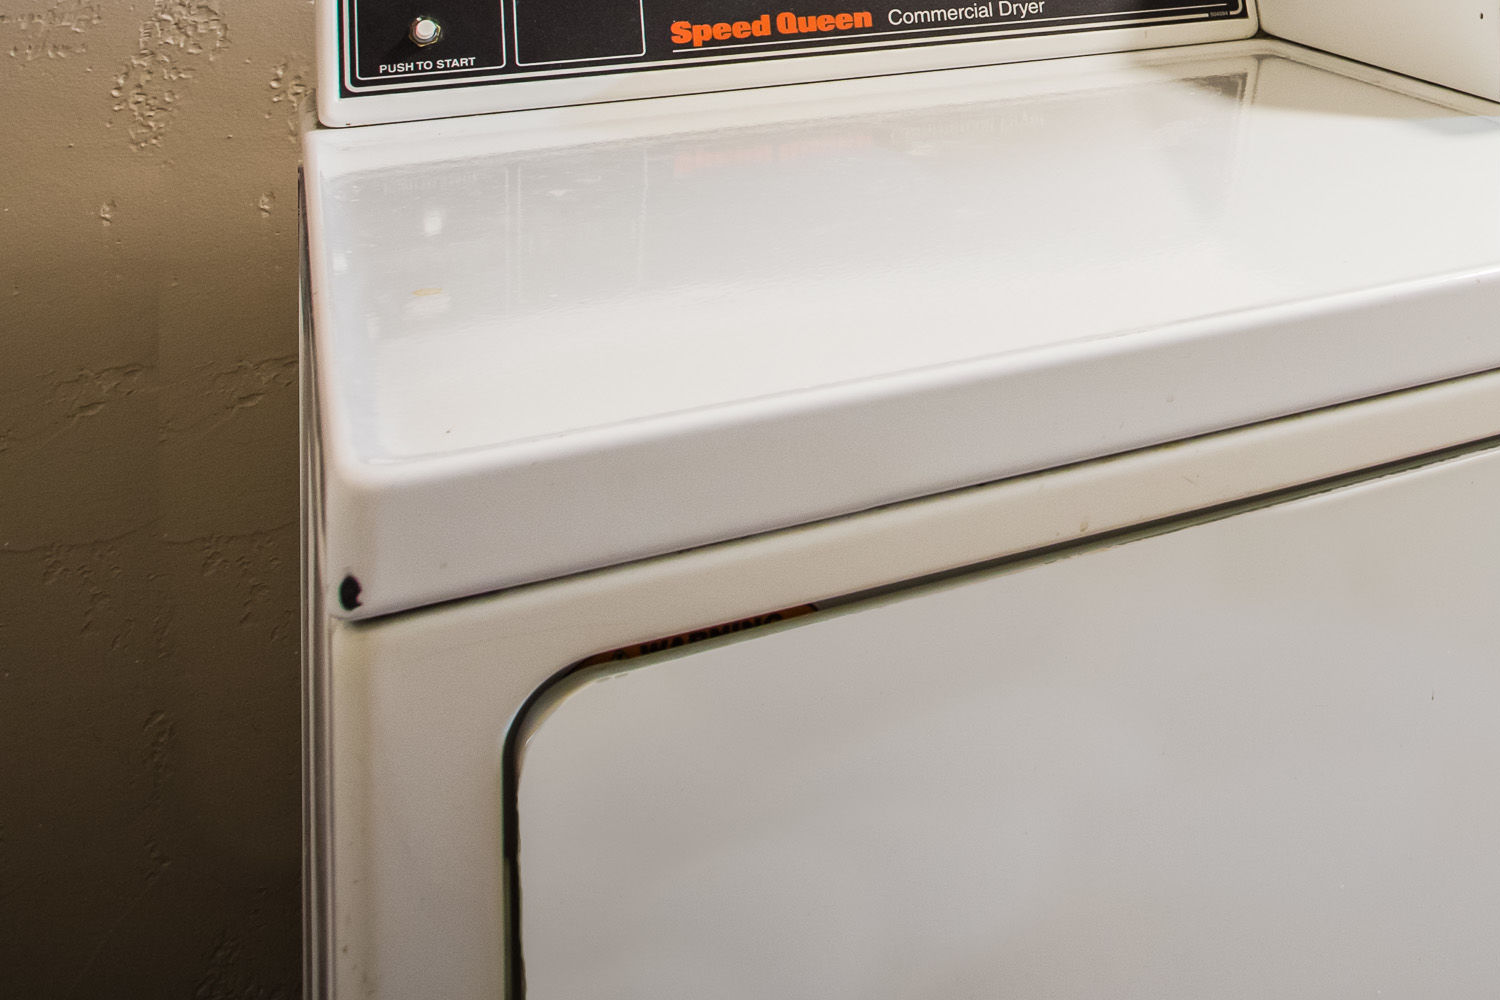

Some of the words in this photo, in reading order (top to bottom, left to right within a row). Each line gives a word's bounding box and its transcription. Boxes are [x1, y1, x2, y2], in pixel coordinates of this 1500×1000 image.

[670, 14, 772, 47] Speed
[776, 11, 873, 34] Queen
[887, 2, 993, 26] Commercial
[998, 0, 1045, 18] Dryer
[379, 64, 414, 74] PUSH
[416, 61, 433, 70] TO
[436, 57, 476, 69] START
